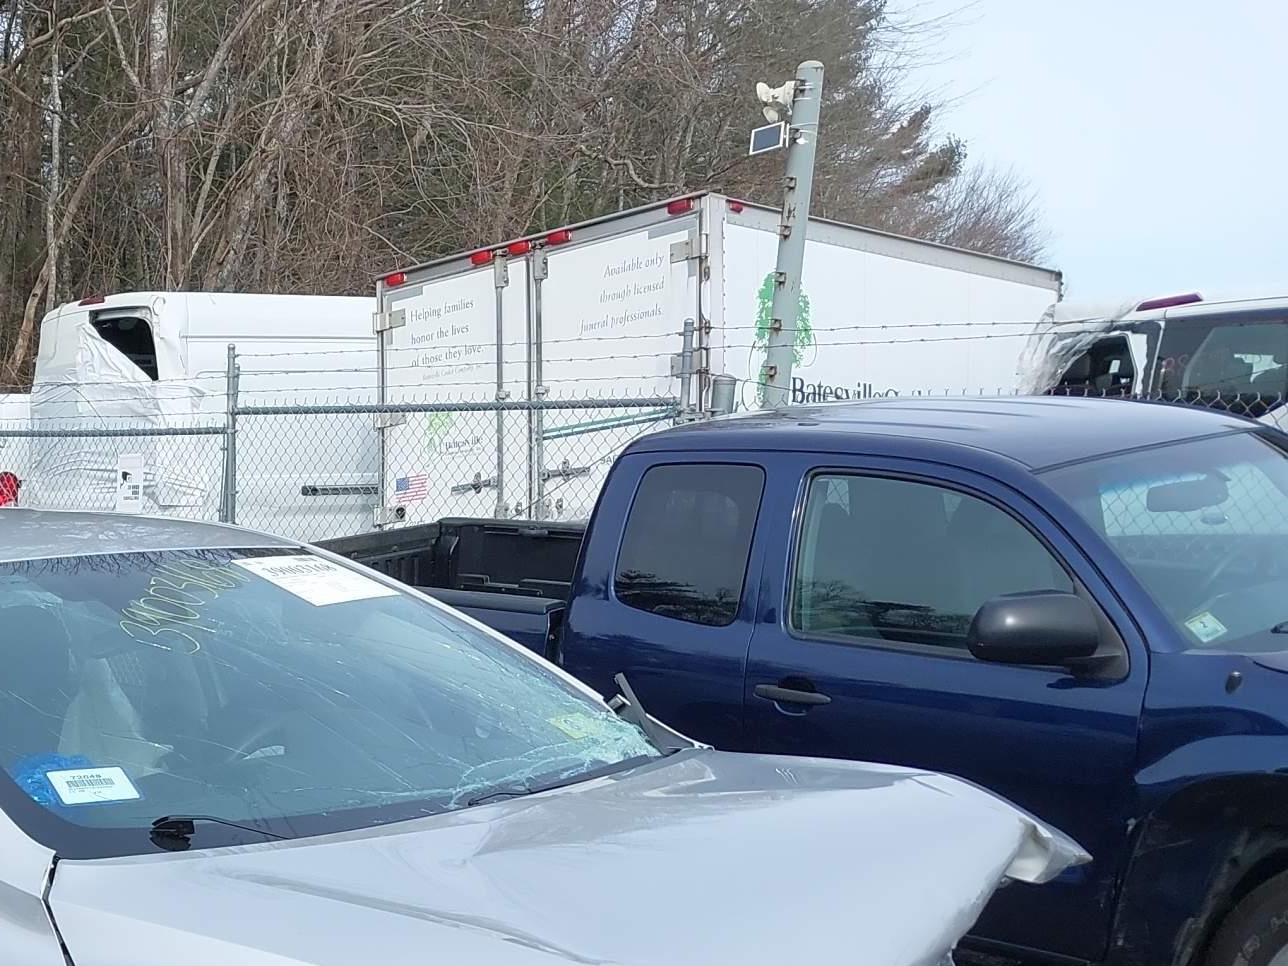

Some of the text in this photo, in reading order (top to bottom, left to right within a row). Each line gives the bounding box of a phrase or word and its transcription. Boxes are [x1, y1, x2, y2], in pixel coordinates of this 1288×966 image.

[604, 252, 664, 278] Available only
[600, 275, 664, 303] through licensed
[411, 298, 473, 322] Helping families
[411, 323, 469, 345] honor the lives
[579, 314, 608, 336] funeral
[412, 344, 484, 367] of those they love.
[120, 559, 250, 655] 39003168
